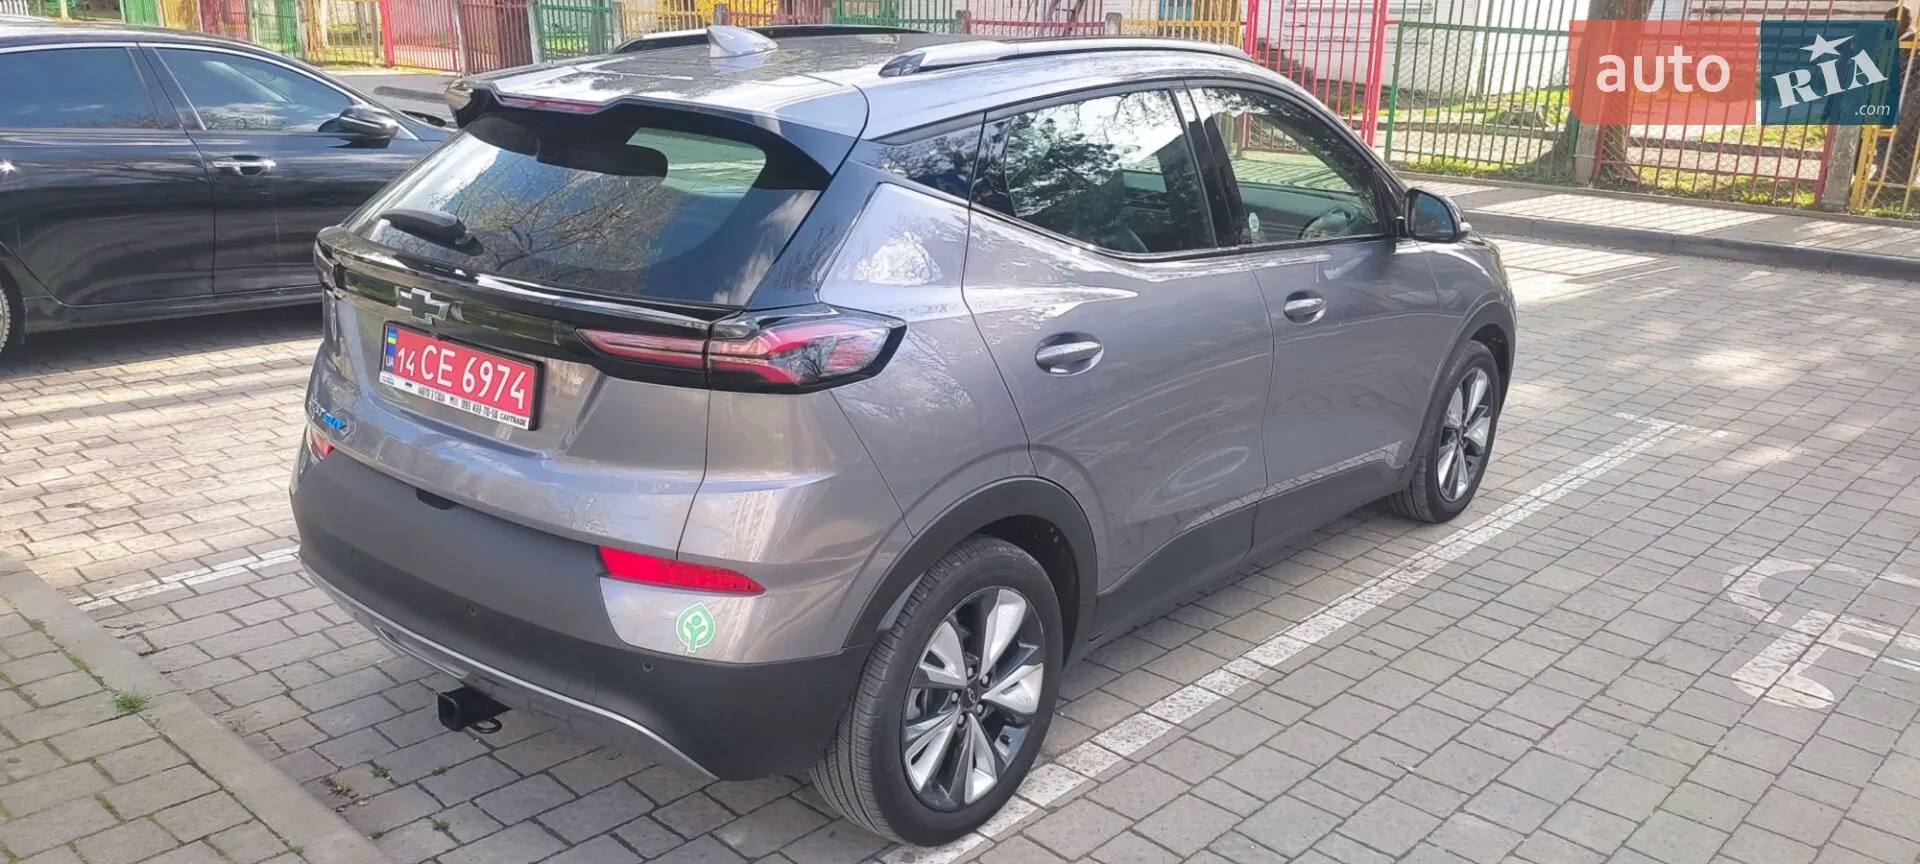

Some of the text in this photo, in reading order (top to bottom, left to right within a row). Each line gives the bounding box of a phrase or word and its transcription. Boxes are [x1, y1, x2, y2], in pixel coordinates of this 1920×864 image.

[385, 355, 394, 367] UA
[397, 344, 526, 410] 14 CE 6974
